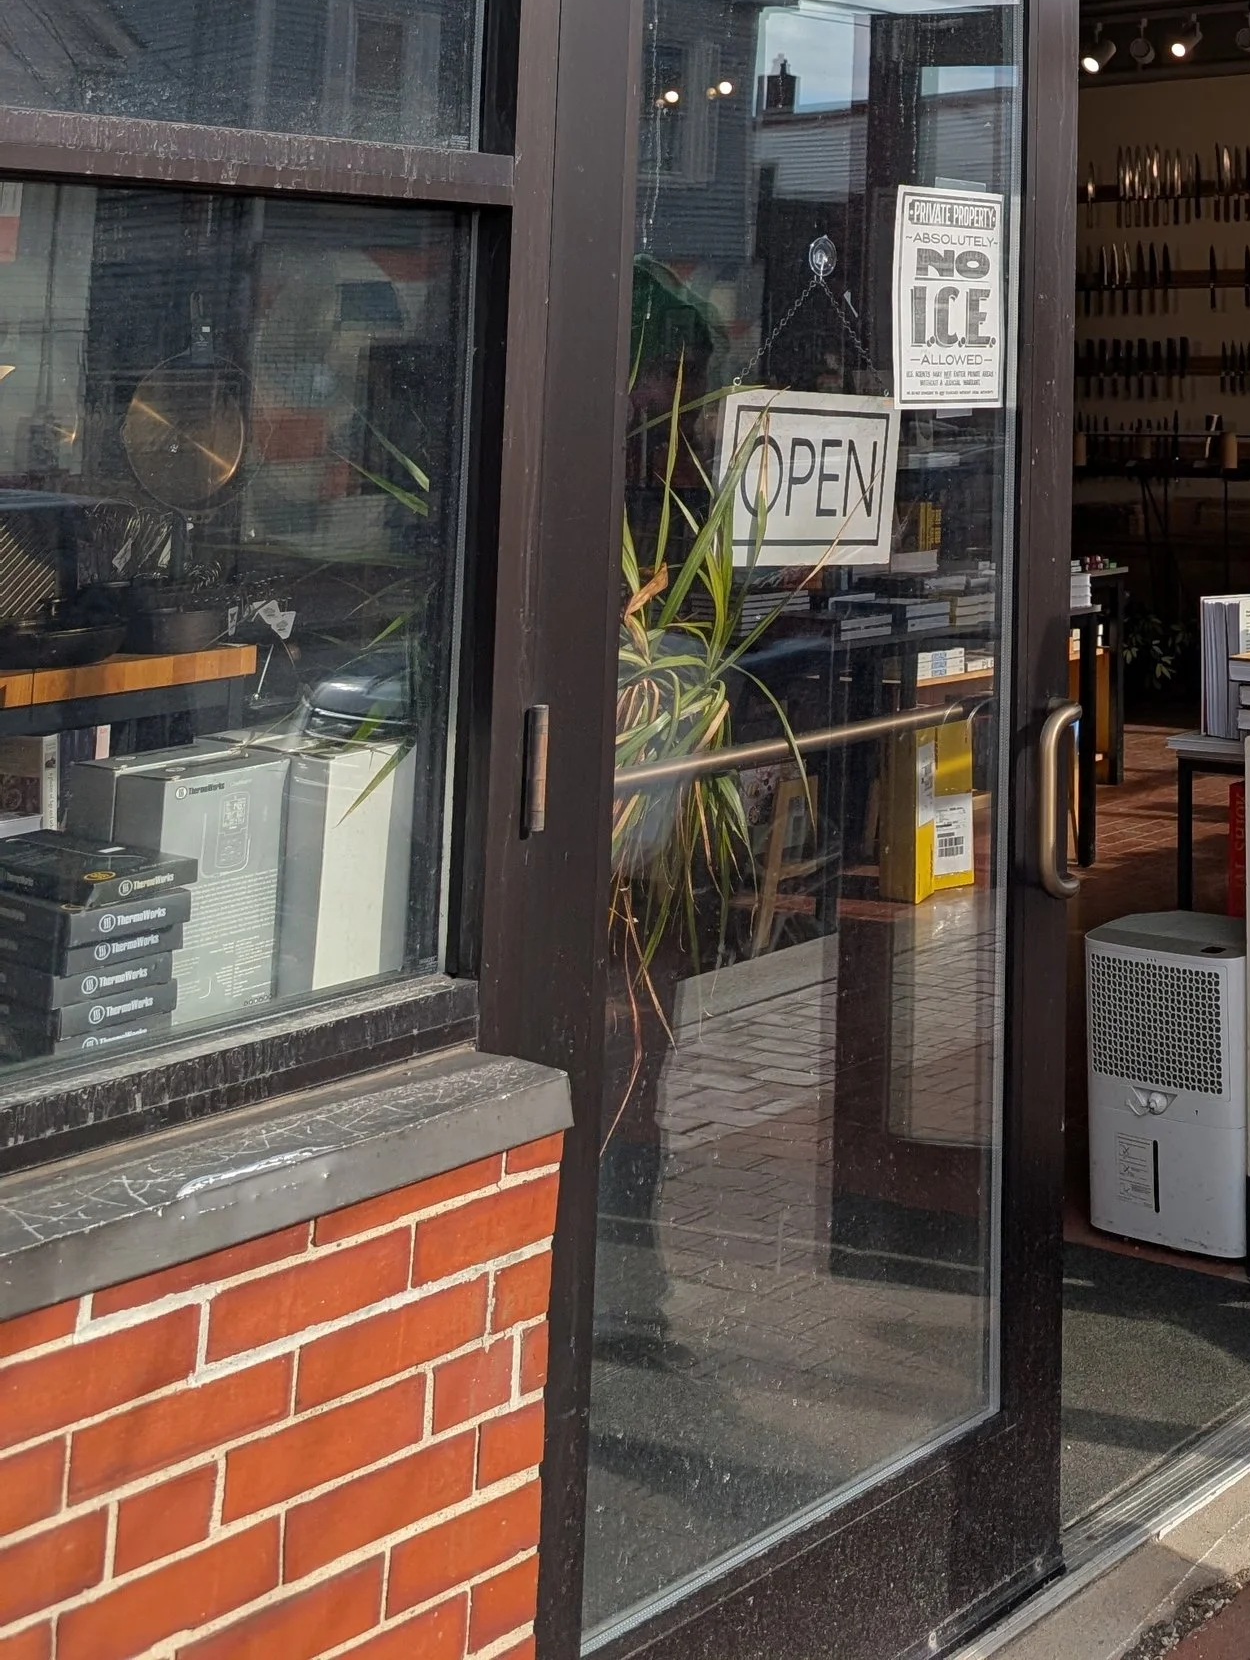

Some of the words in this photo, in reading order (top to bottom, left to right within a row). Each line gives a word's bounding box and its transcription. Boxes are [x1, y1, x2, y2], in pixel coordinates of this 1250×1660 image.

[914, 201, 951, 225] PRIVATE
[953, 204, 994, 229] PROPERTY
[913, 232, 994, 248] ABSOLUTELY
[915, 247, 991, 280] NO
[910, 285, 997, 348] I.C.E.
[920, 354, 984, 366] ALLOWED
[739, 434, 880, 520] OPEN
[188, 782, 226, 796] ThermoWorks
[132, 872, 175, 891] ThermoWorks
[116, 906, 167, 926] ThermoWorks
[111, 932, 160, 954] ThermoWorks
[98, 966, 148, 988] ThermoWorks
[105, 995, 154, 1018] ThermoWorks
